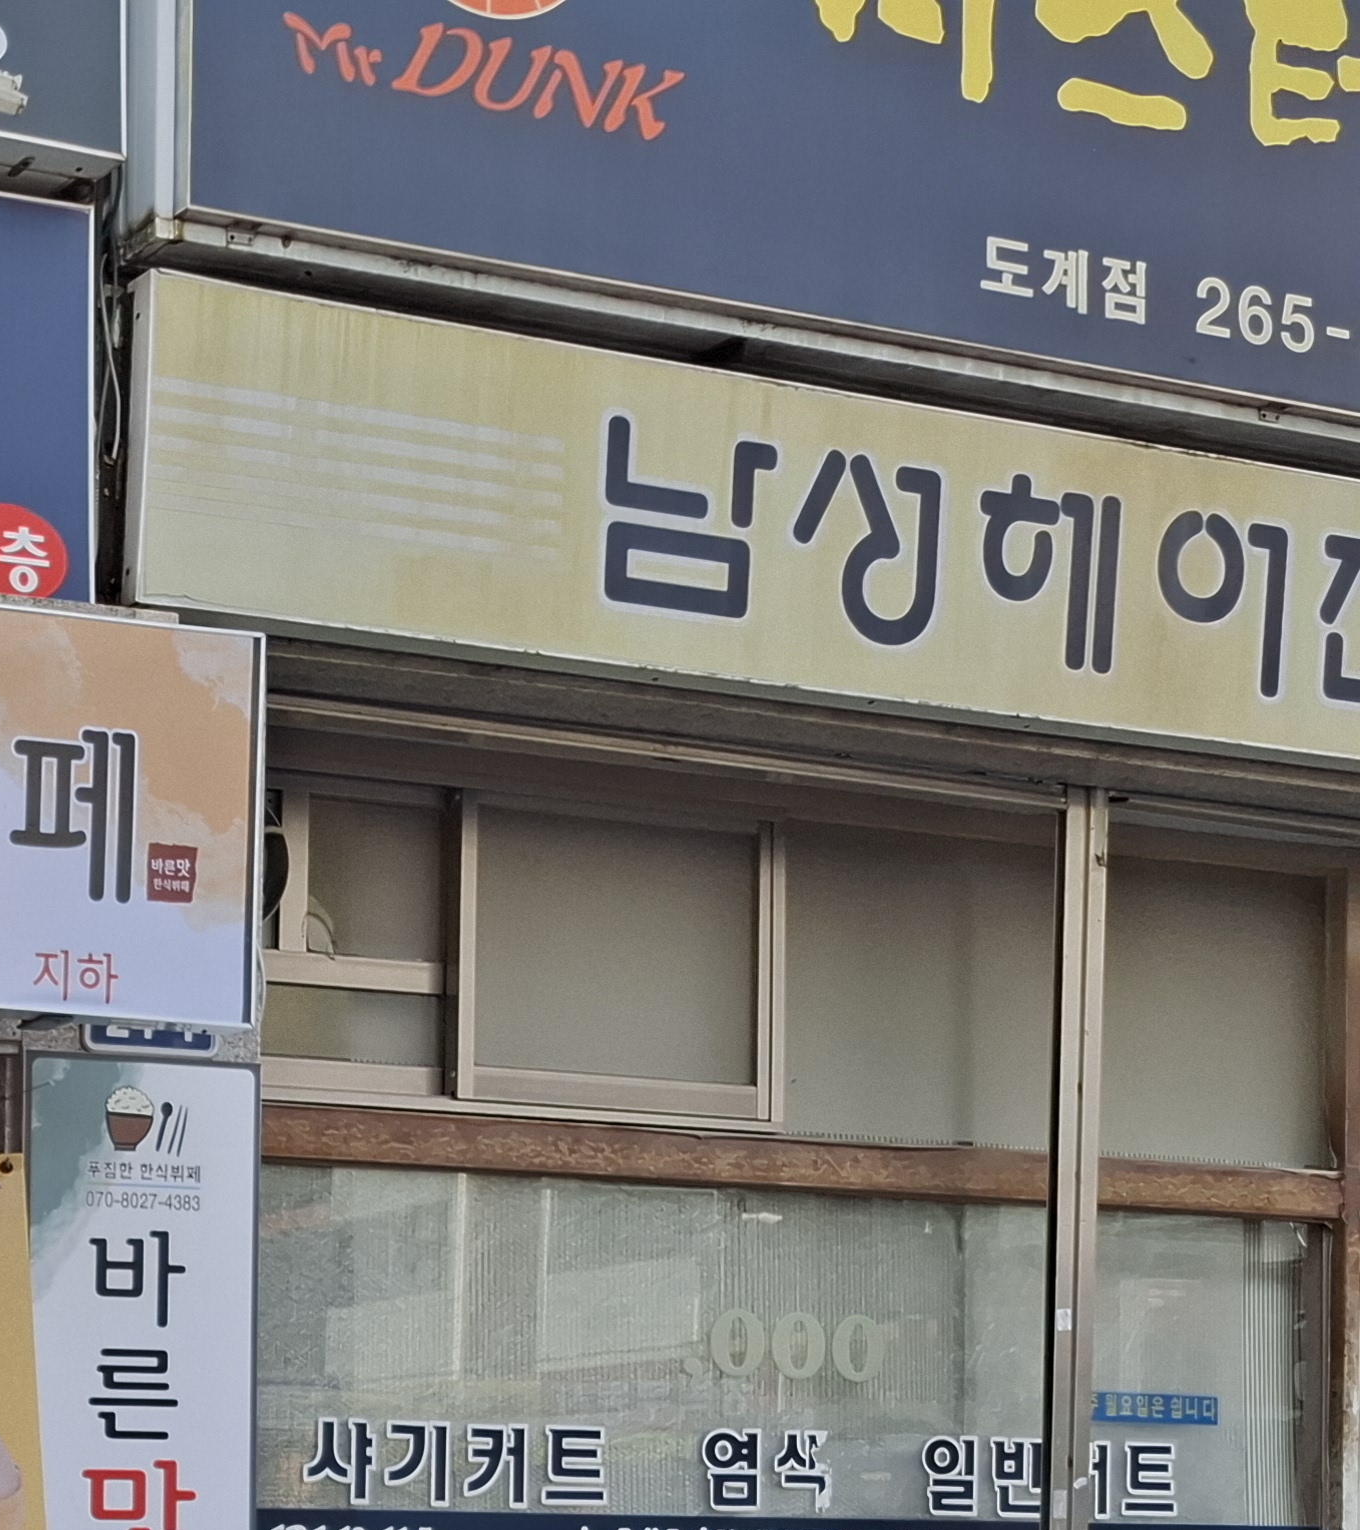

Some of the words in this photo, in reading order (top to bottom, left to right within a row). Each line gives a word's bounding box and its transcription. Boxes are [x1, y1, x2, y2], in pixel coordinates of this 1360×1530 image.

[390, 22, 686, 141] DUNK
[979, 236, 1147, 325] 도계점
[150, 857, 192, 878] 바른맛
[32, 949, 119, 1004] 지하
[87, 1160, 133, 1180] 푸짐한
[140, 1163, 201, 1184] 한식뷔페
[85, 1190, 201, 1212] 070-8027-4383
[302, 1417, 608, 1508] 샤기커트
